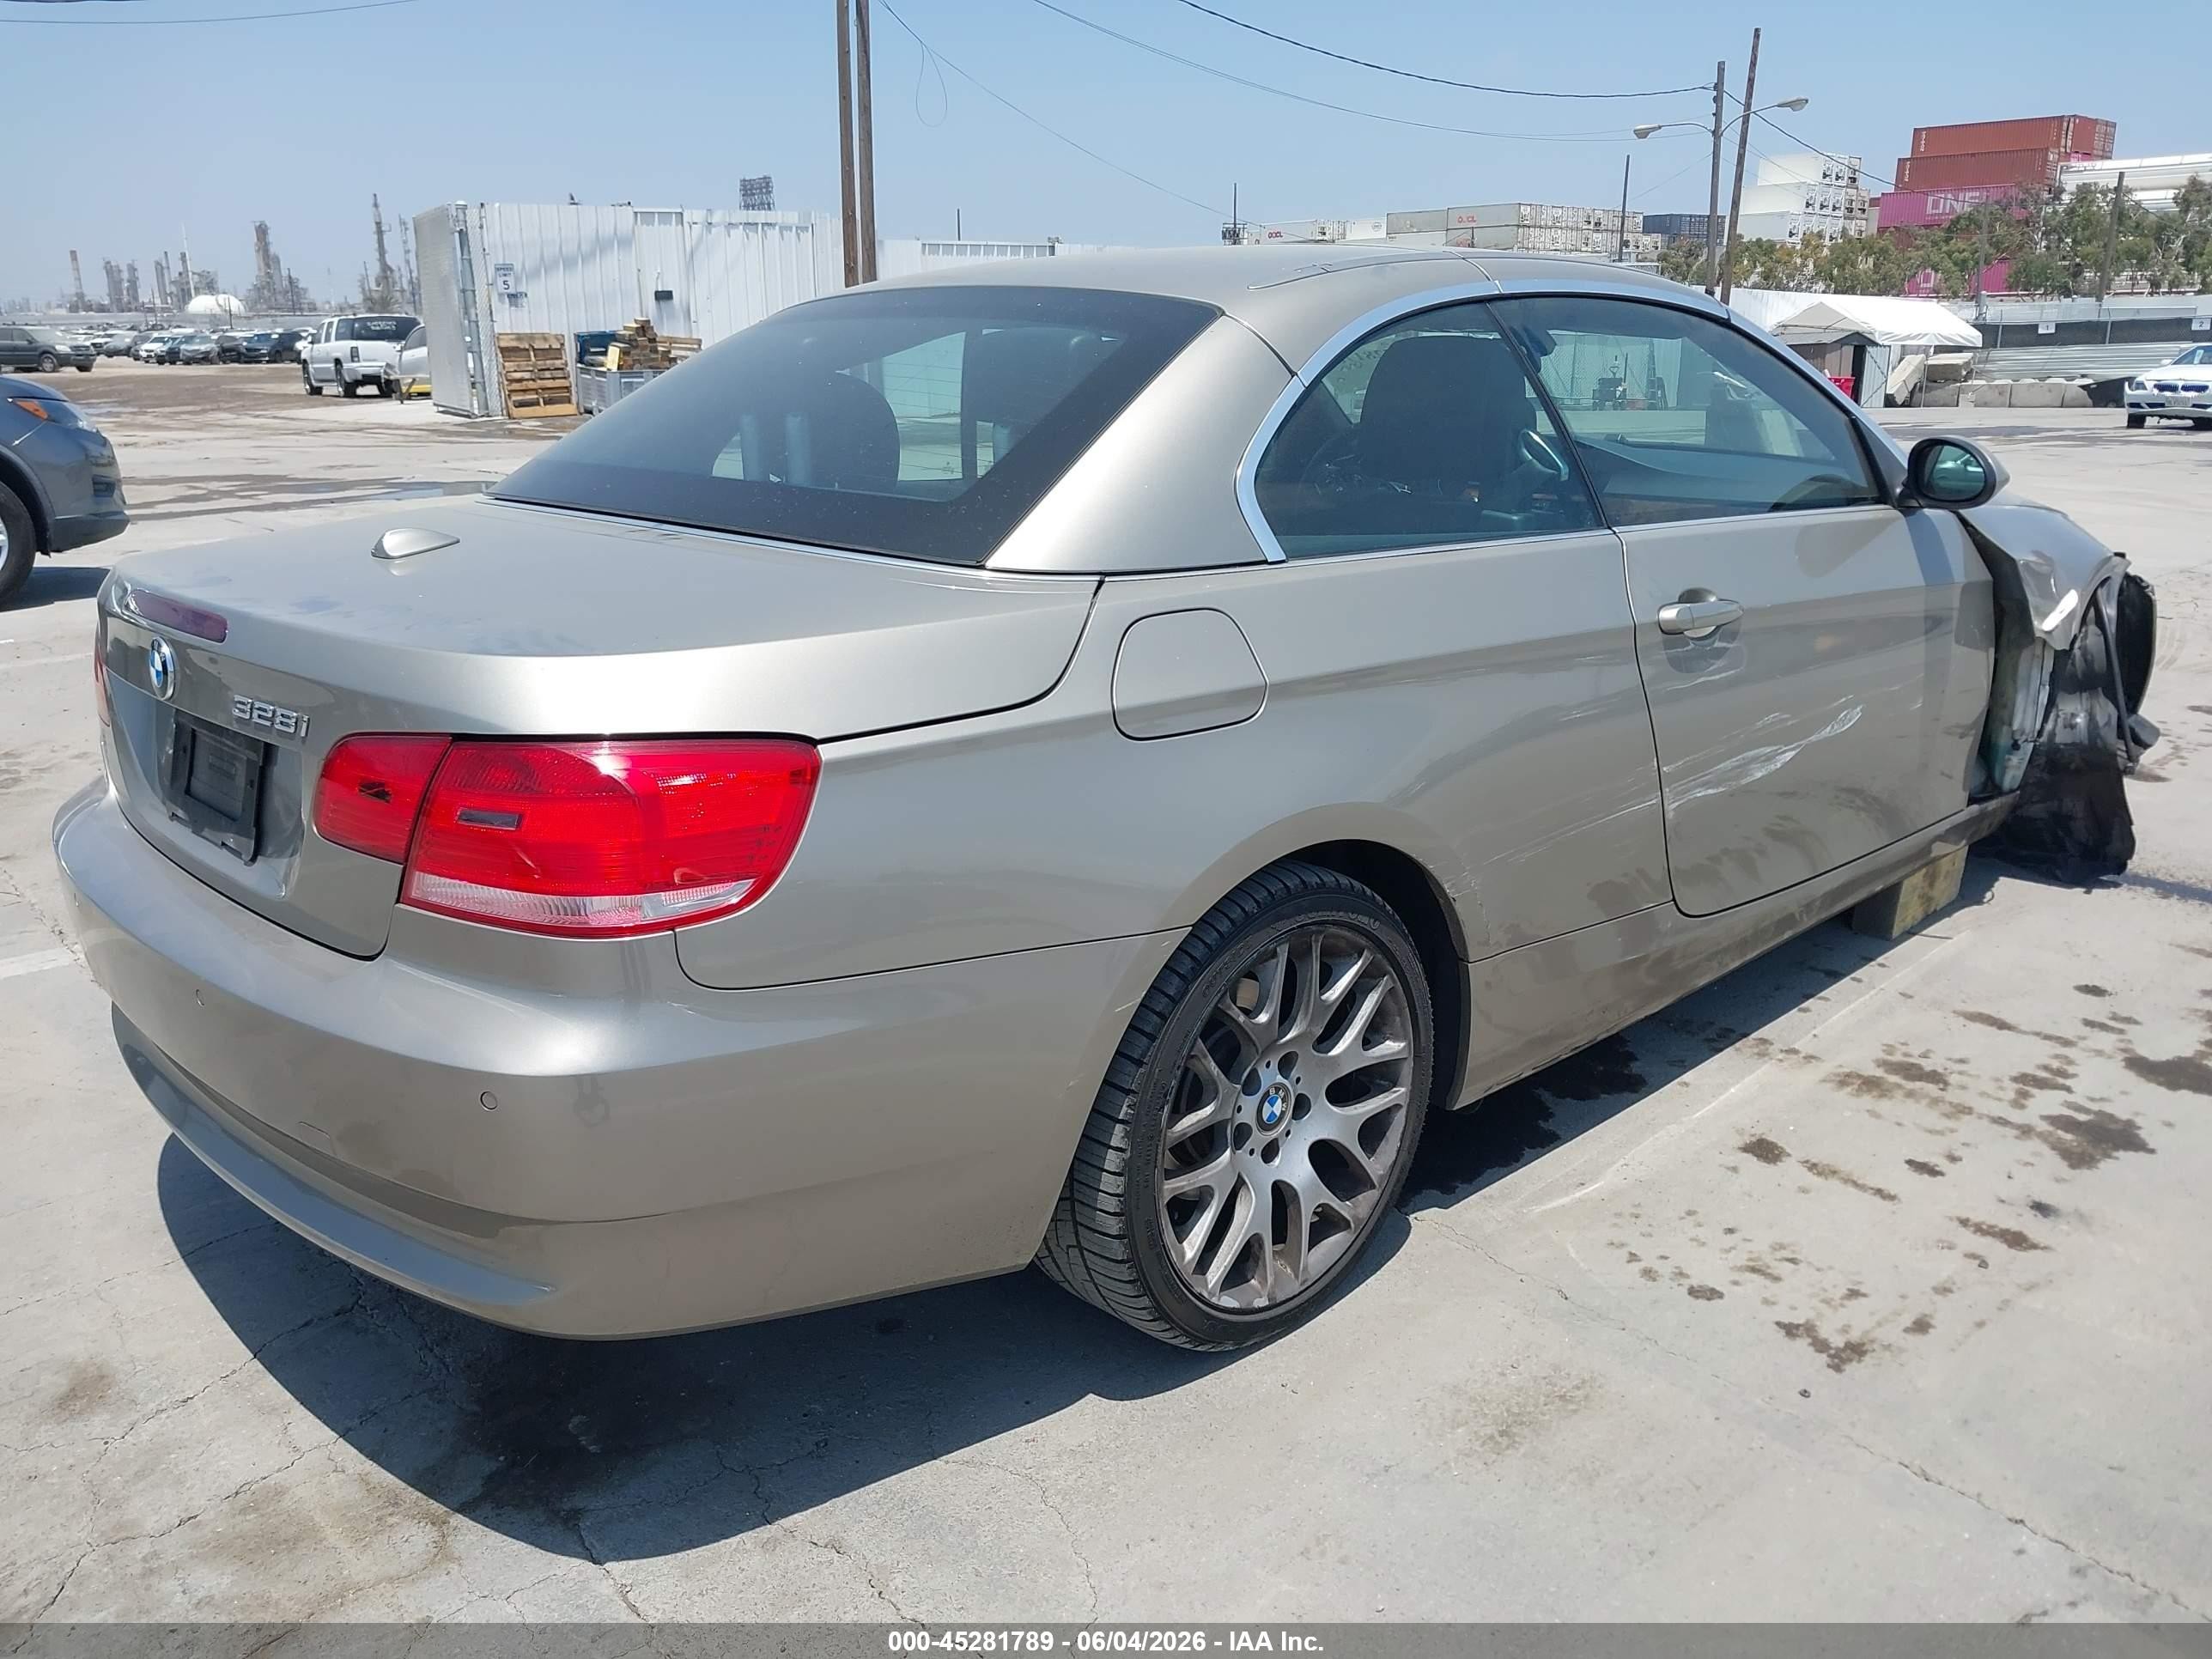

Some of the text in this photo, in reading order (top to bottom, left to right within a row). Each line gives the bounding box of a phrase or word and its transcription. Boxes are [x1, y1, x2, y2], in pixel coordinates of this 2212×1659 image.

[502, 280, 510, 290] 5
[232, 694, 310, 738] 328i
[1269, 1087, 1288, 1112] BMW
